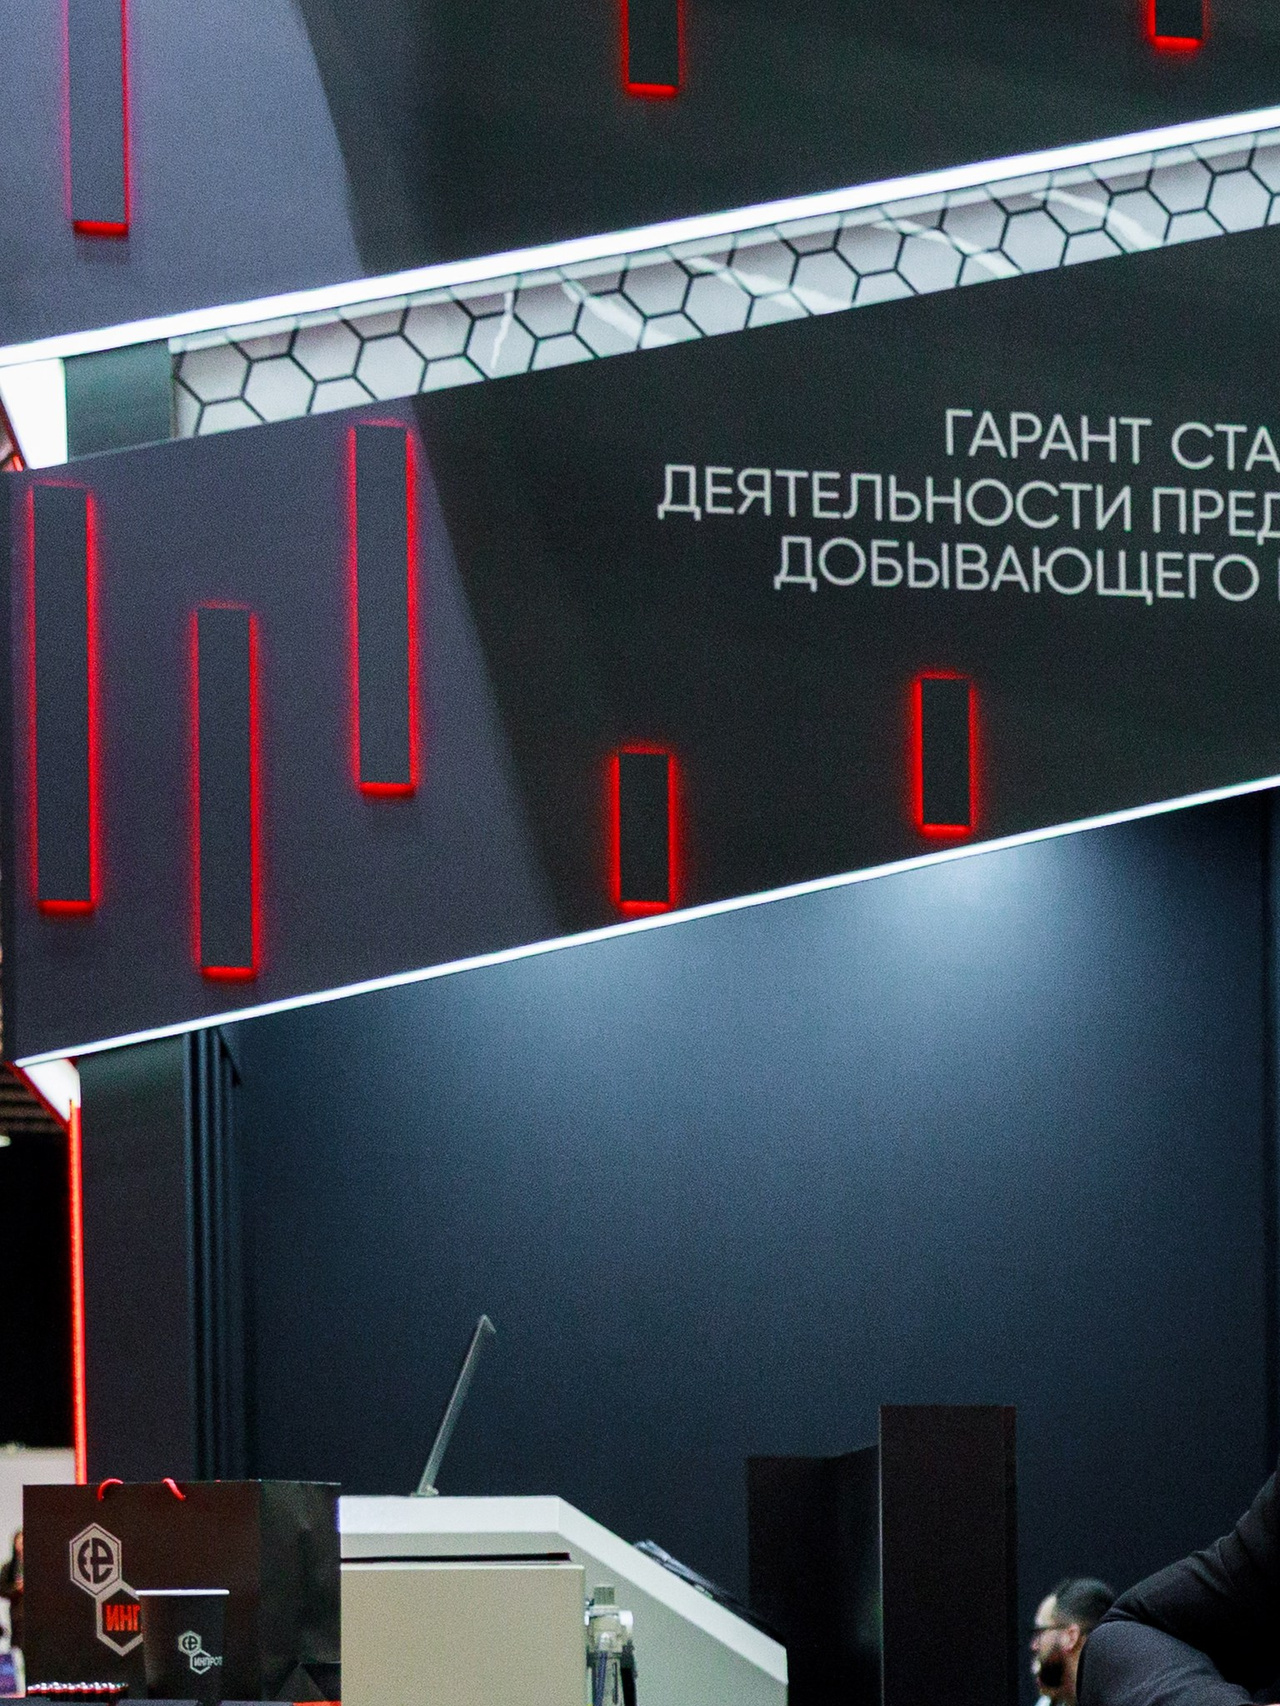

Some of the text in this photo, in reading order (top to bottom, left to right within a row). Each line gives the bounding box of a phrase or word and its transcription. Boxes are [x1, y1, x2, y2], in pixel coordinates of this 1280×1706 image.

[945, 408, 1153, 465] ГАРАНТ
[657, 463, 1132, 532] ДЕЯТЕЛЬНОСТИ
[773, 535, 1260, 604] ДОБЫВАЮЩЕГО
